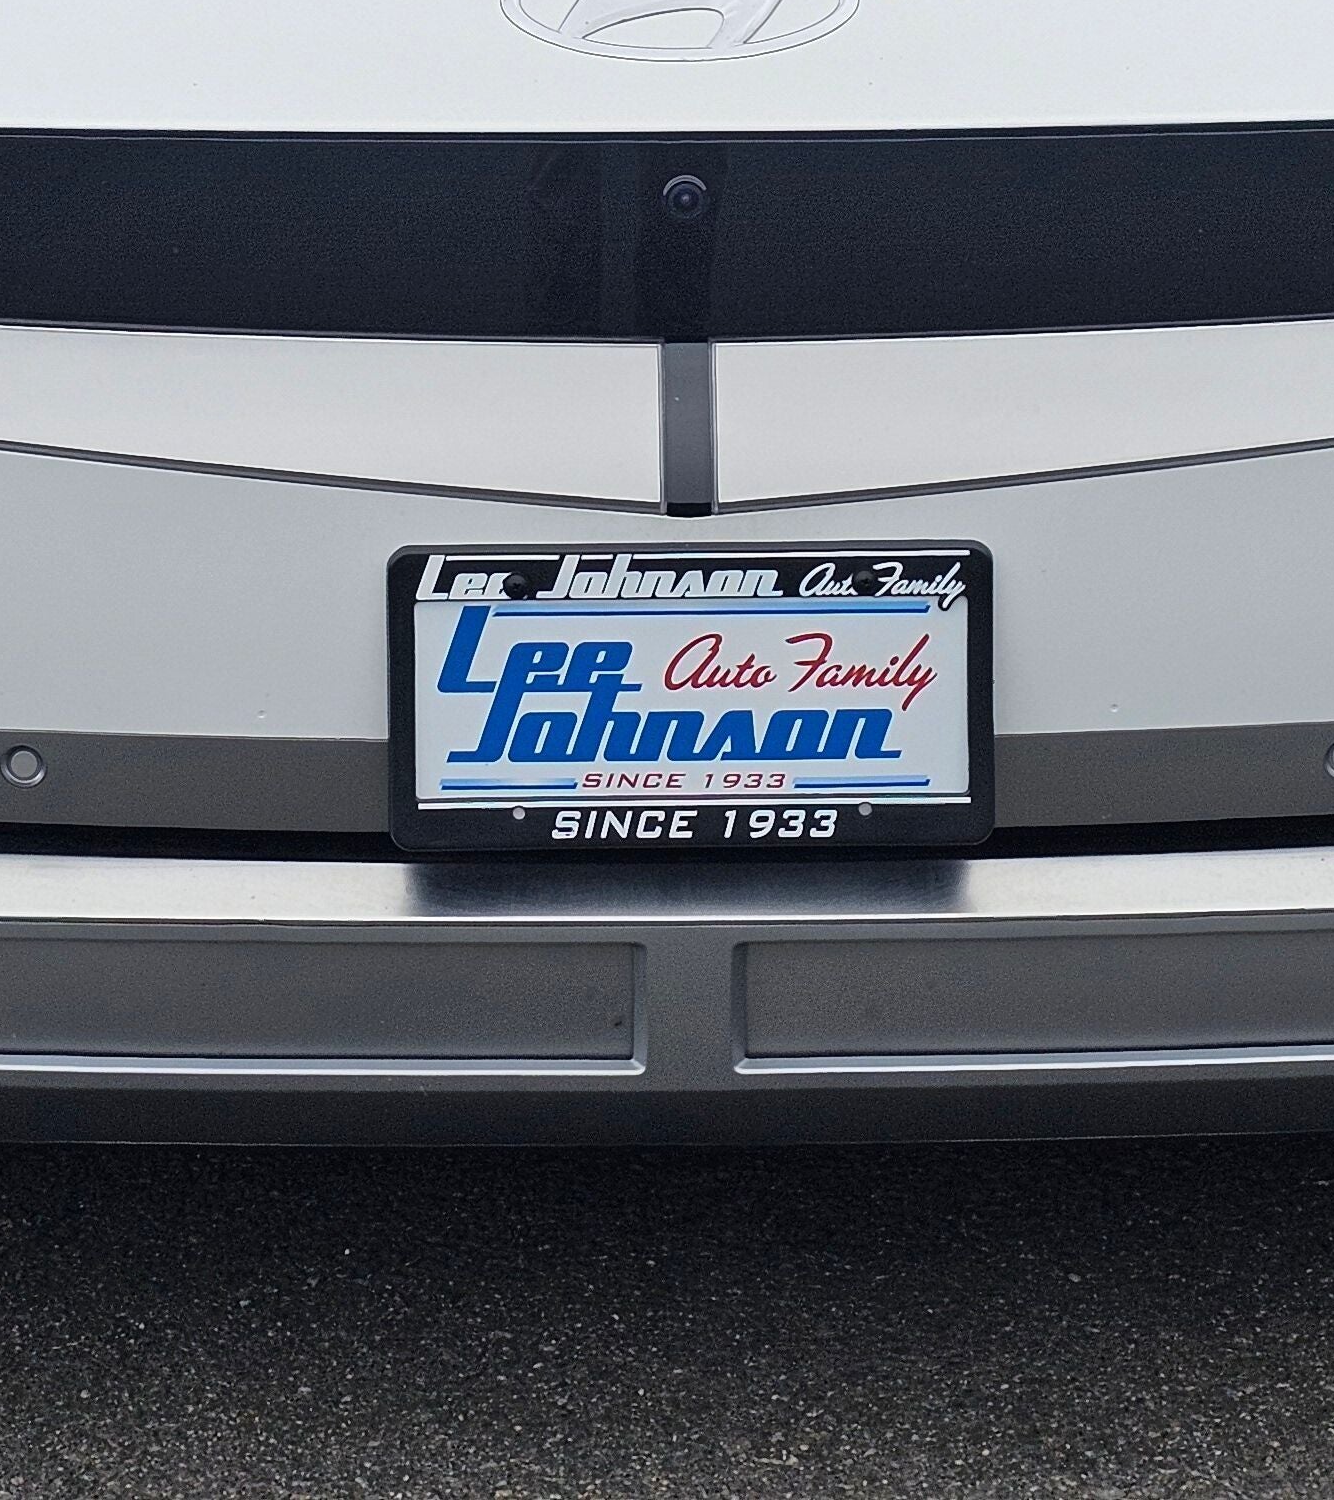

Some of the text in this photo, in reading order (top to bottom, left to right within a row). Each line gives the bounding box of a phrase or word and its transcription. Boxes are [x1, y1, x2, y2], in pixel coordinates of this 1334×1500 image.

[535, 552, 784, 599] Johnson
[798, 562, 866, 597] Aut
[872, 561, 966, 608] Family
[437, 605, 643, 694] Lee
[664, 632, 938, 712] Auto Family
[446, 688, 903, 763] Johnson
[581, 772, 787, 789] SINCE 1933
[551, 808, 839, 840] SINCE 1933
